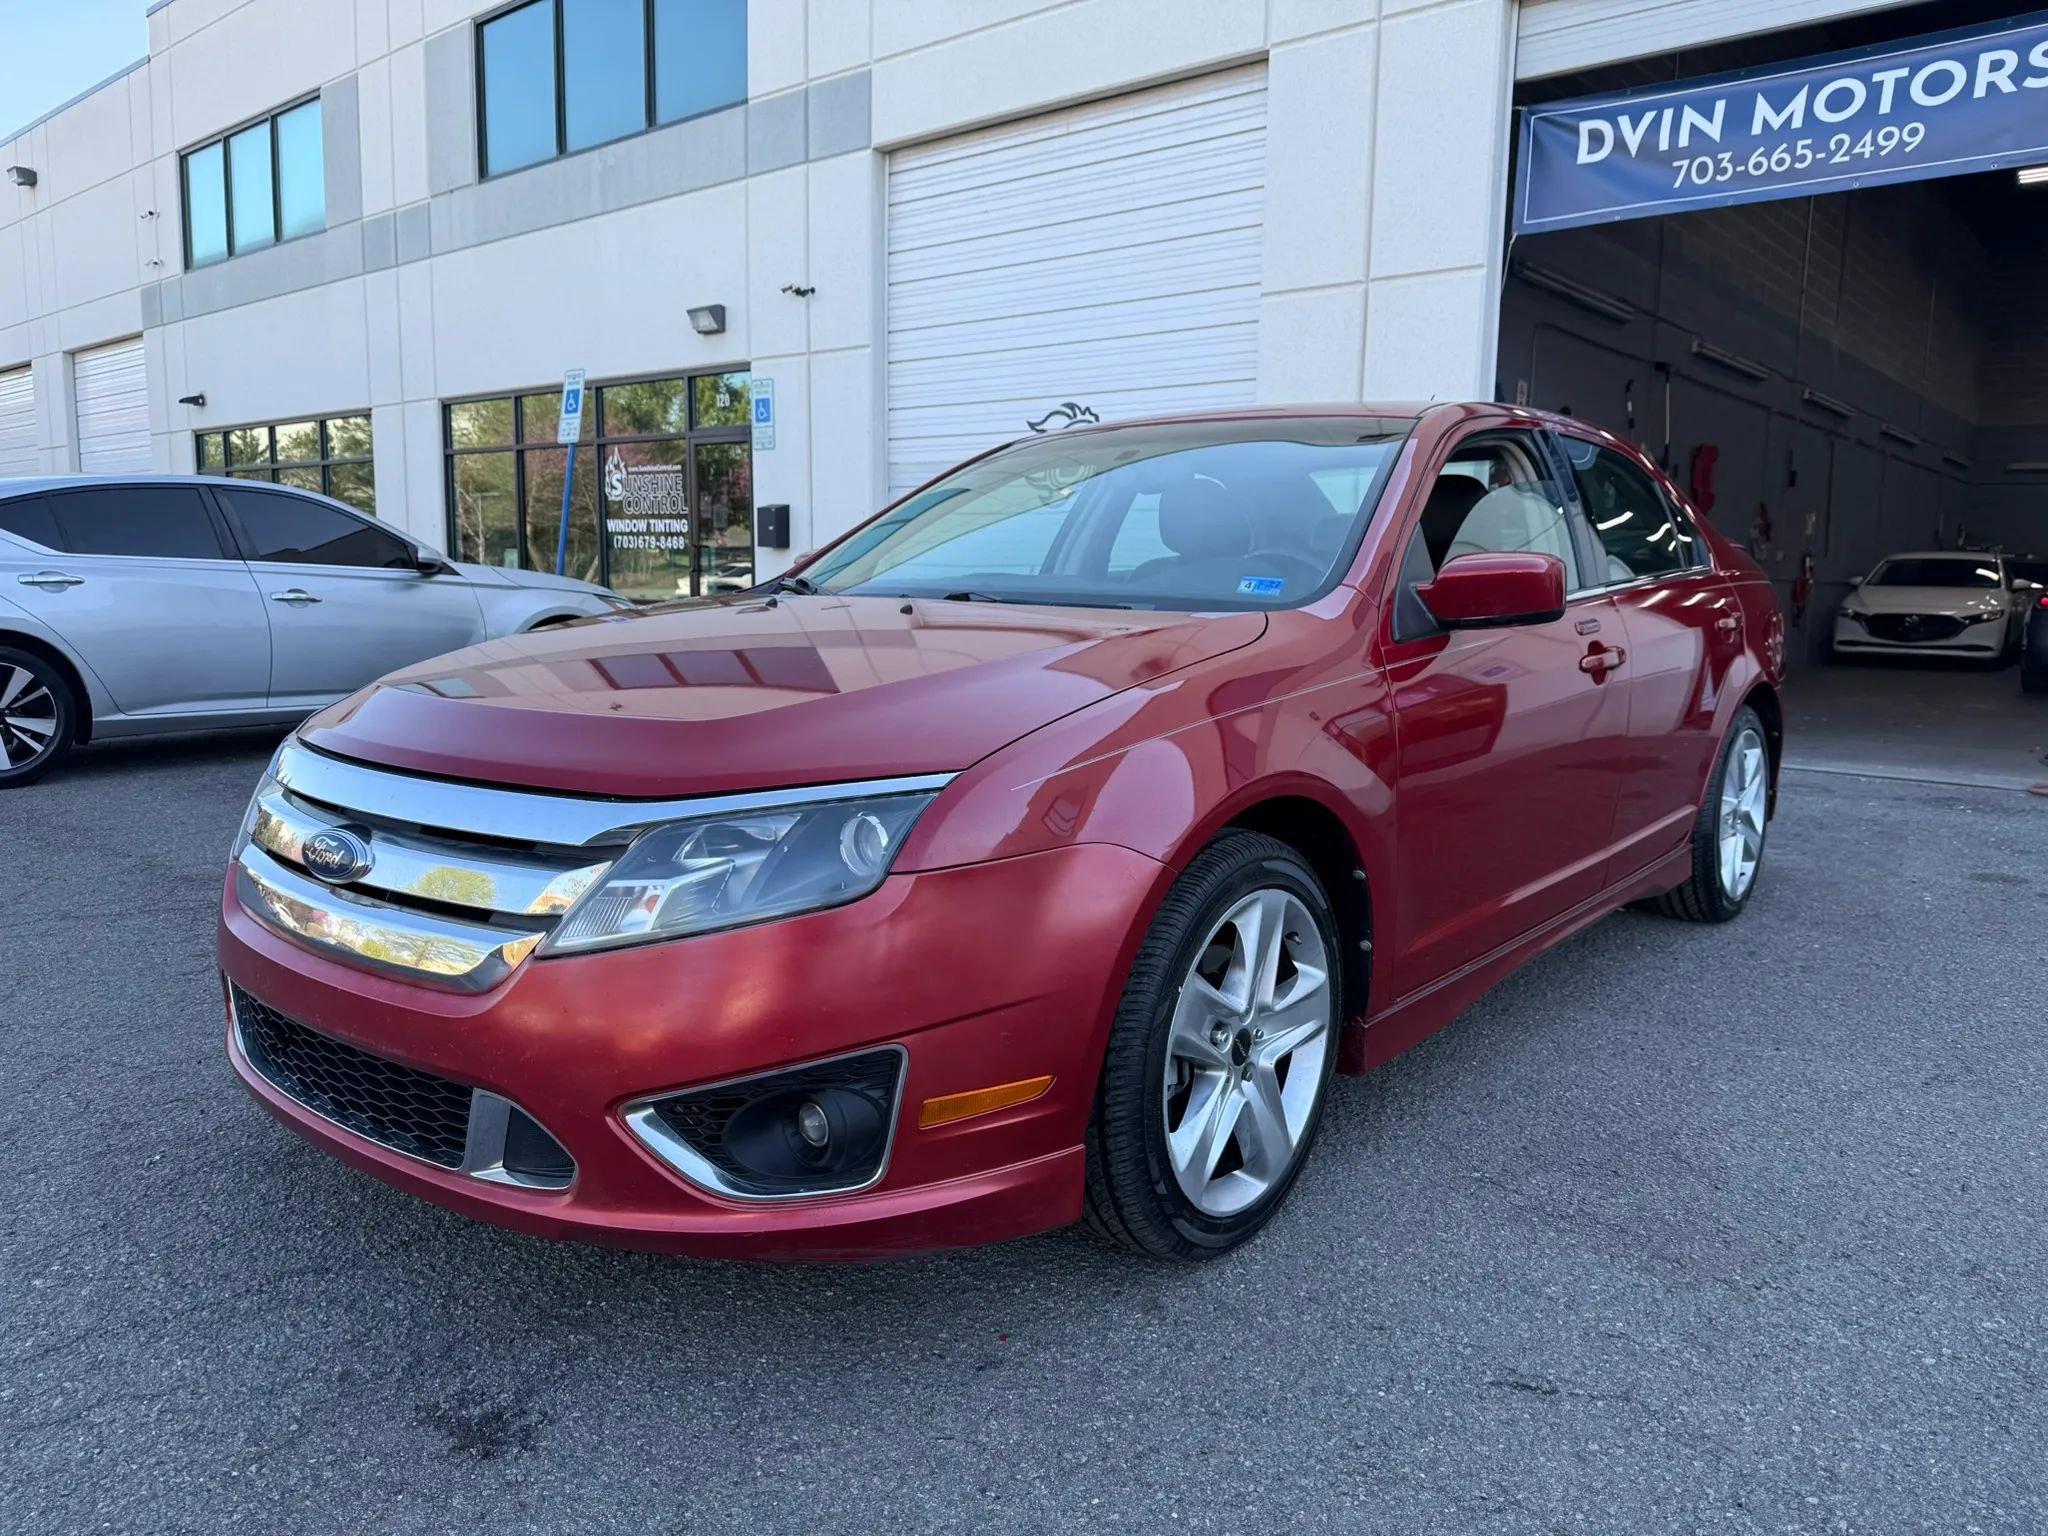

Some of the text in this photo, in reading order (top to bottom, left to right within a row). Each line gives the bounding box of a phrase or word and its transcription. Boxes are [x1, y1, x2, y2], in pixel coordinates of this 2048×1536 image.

[1576, 40, 2048, 165] DVIN MOTORS
[1671, 121, 1926, 188] 703-665-2499
[716, 393, 730, 407] 120
[611, 473, 683, 496] SUNSHINE
[623, 494, 688, 514] CONTROL
[607, 519, 688, 533] WINDOW TINTING
[305, 836, 345, 869] Ford
